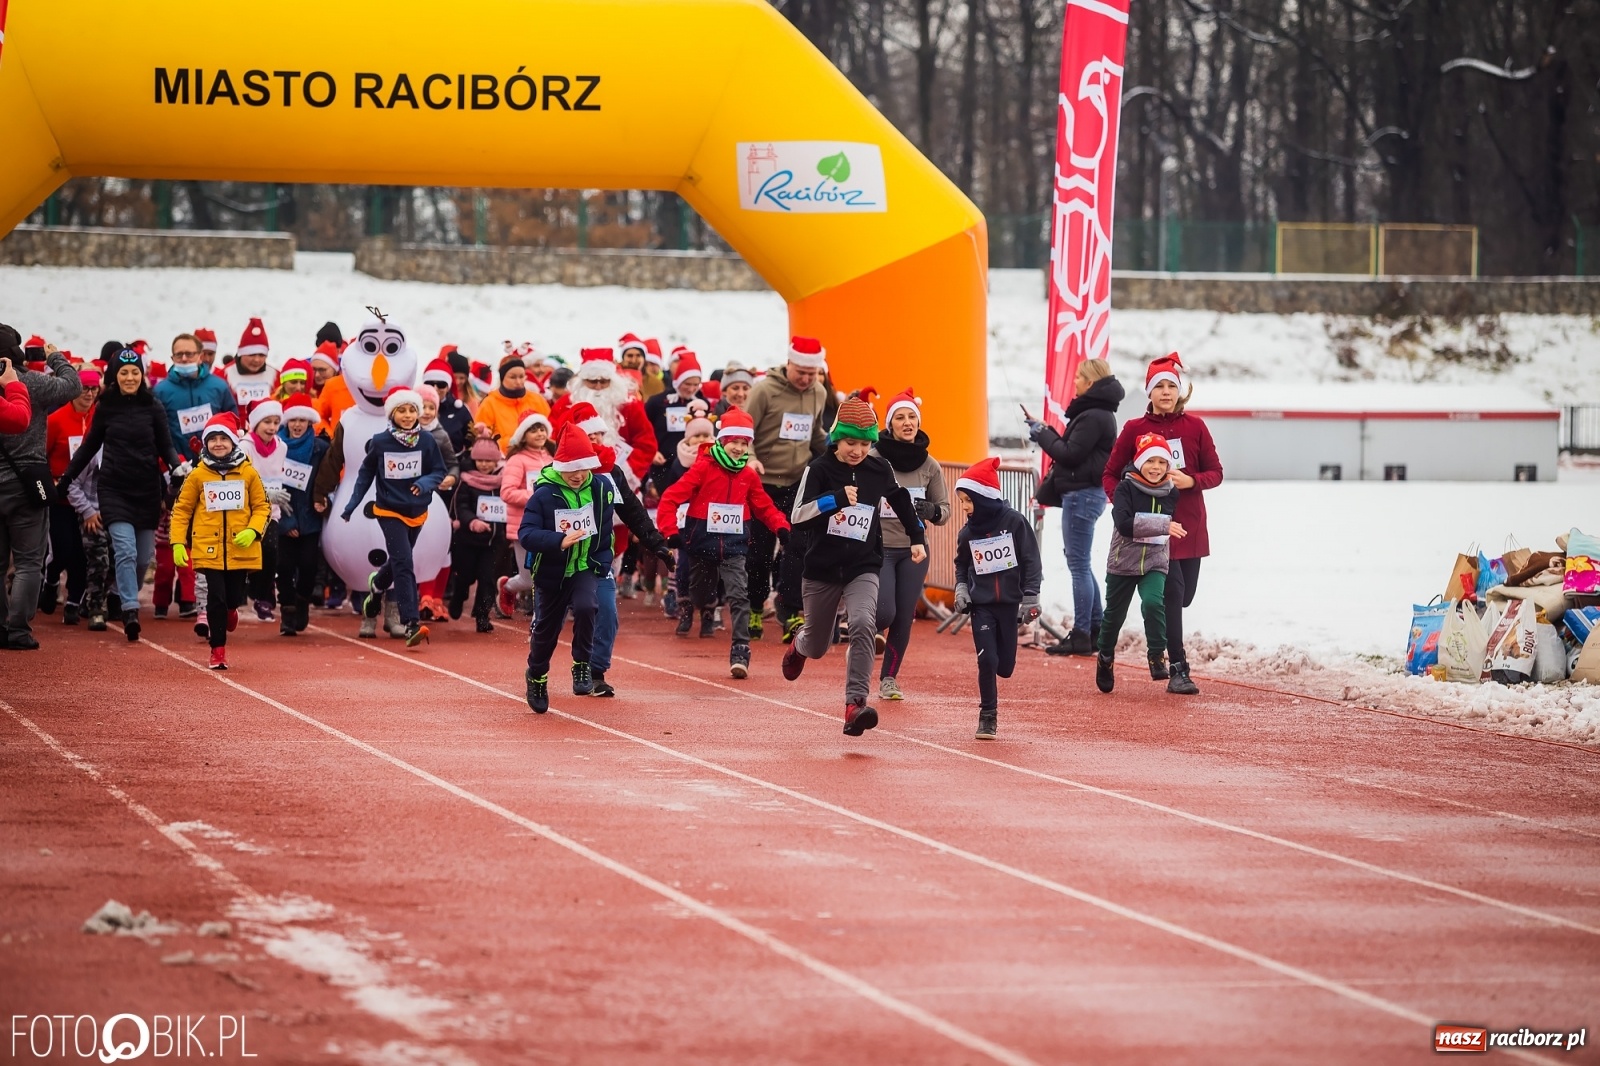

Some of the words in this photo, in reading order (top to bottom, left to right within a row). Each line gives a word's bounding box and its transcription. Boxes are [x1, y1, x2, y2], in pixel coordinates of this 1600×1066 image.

[153, 66, 337, 108] MIASTO
[353, 66, 601, 112] RACIBÓRZ
[753, 169, 877, 211] Racibórz
[249, 389, 265, 398] 157
[191, 412, 209, 424] 097
[793, 423, 810, 432] 030
[397, 460, 419, 471] 047
[285, 468, 306, 482] 022
[218, 490, 241, 501] 008
[490, 505, 504, 514] 185
[572, 515, 591, 531] 016
[722, 514, 741, 525] 070
[847, 514, 870, 530] 042
[984, 545, 1012, 562] 002
